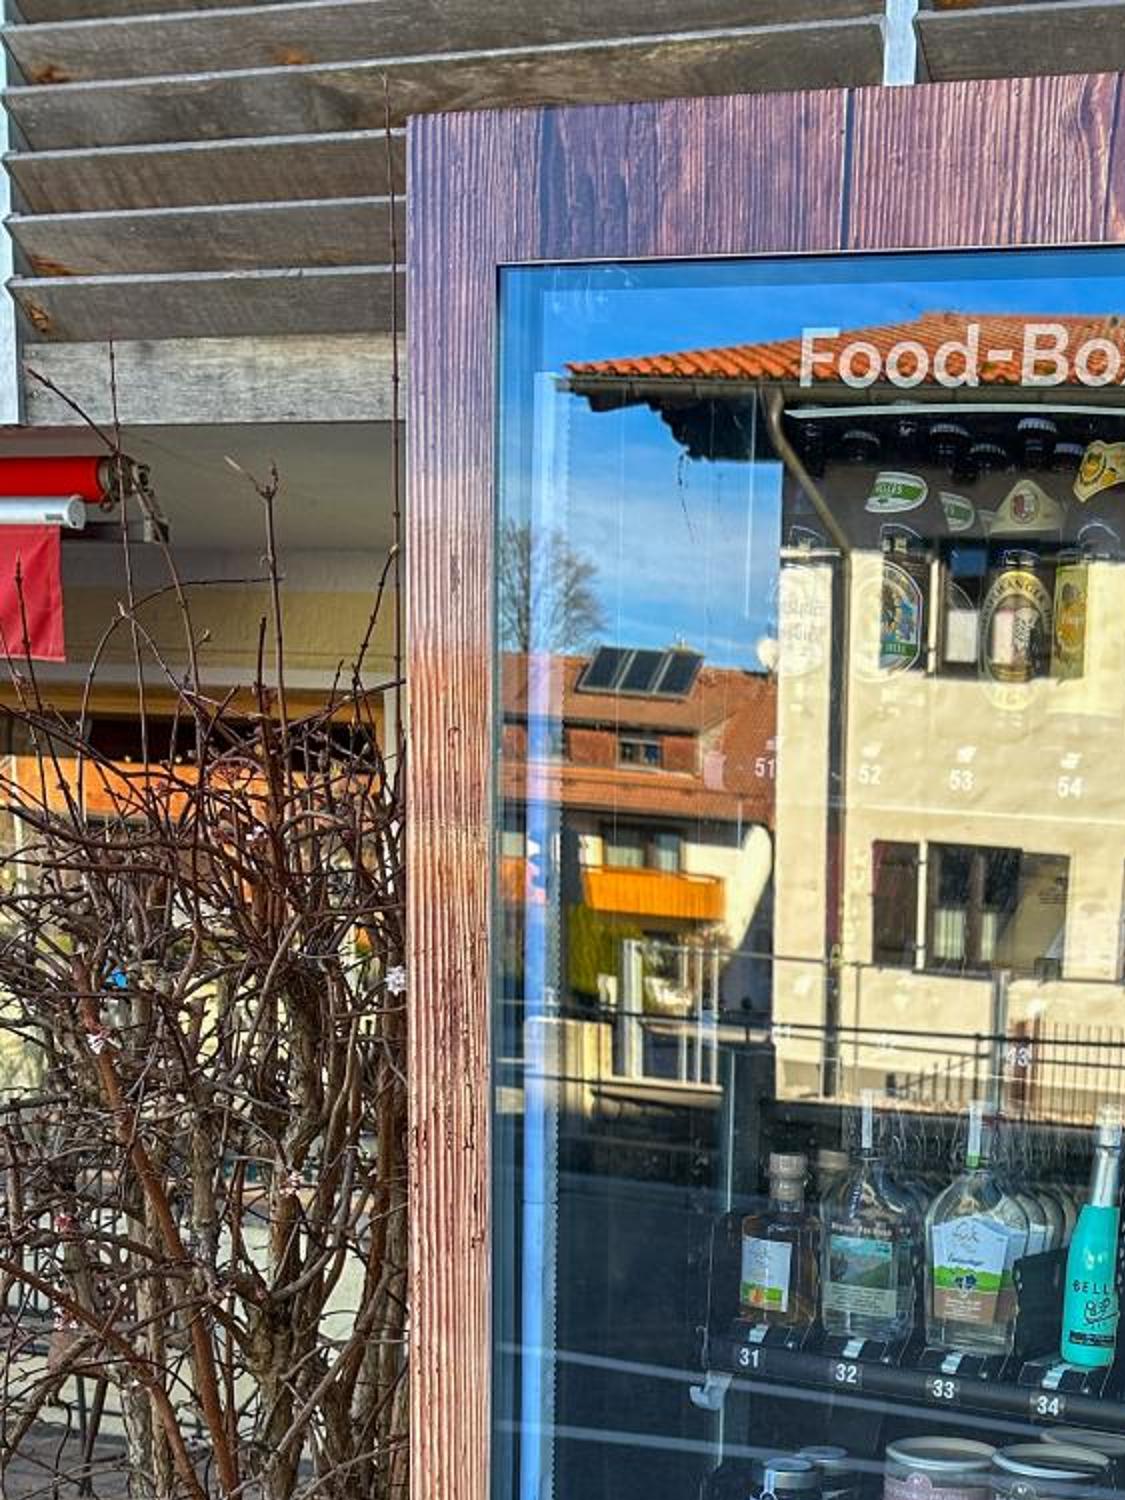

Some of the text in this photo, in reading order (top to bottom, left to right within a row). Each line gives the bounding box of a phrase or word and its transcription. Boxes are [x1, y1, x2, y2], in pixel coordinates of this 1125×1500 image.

[755, 758, 776, 778] 51
[859, 764, 881, 785] 52
[950, 770, 974, 791] 53
[1057, 777, 1082, 798] 54
[739, 1349, 760, 1367] 31
[835, 1365, 857, 1383] 32
[933, 1381, 955, 1399] 33
[1036, 1396, 1059, 1416] 34
